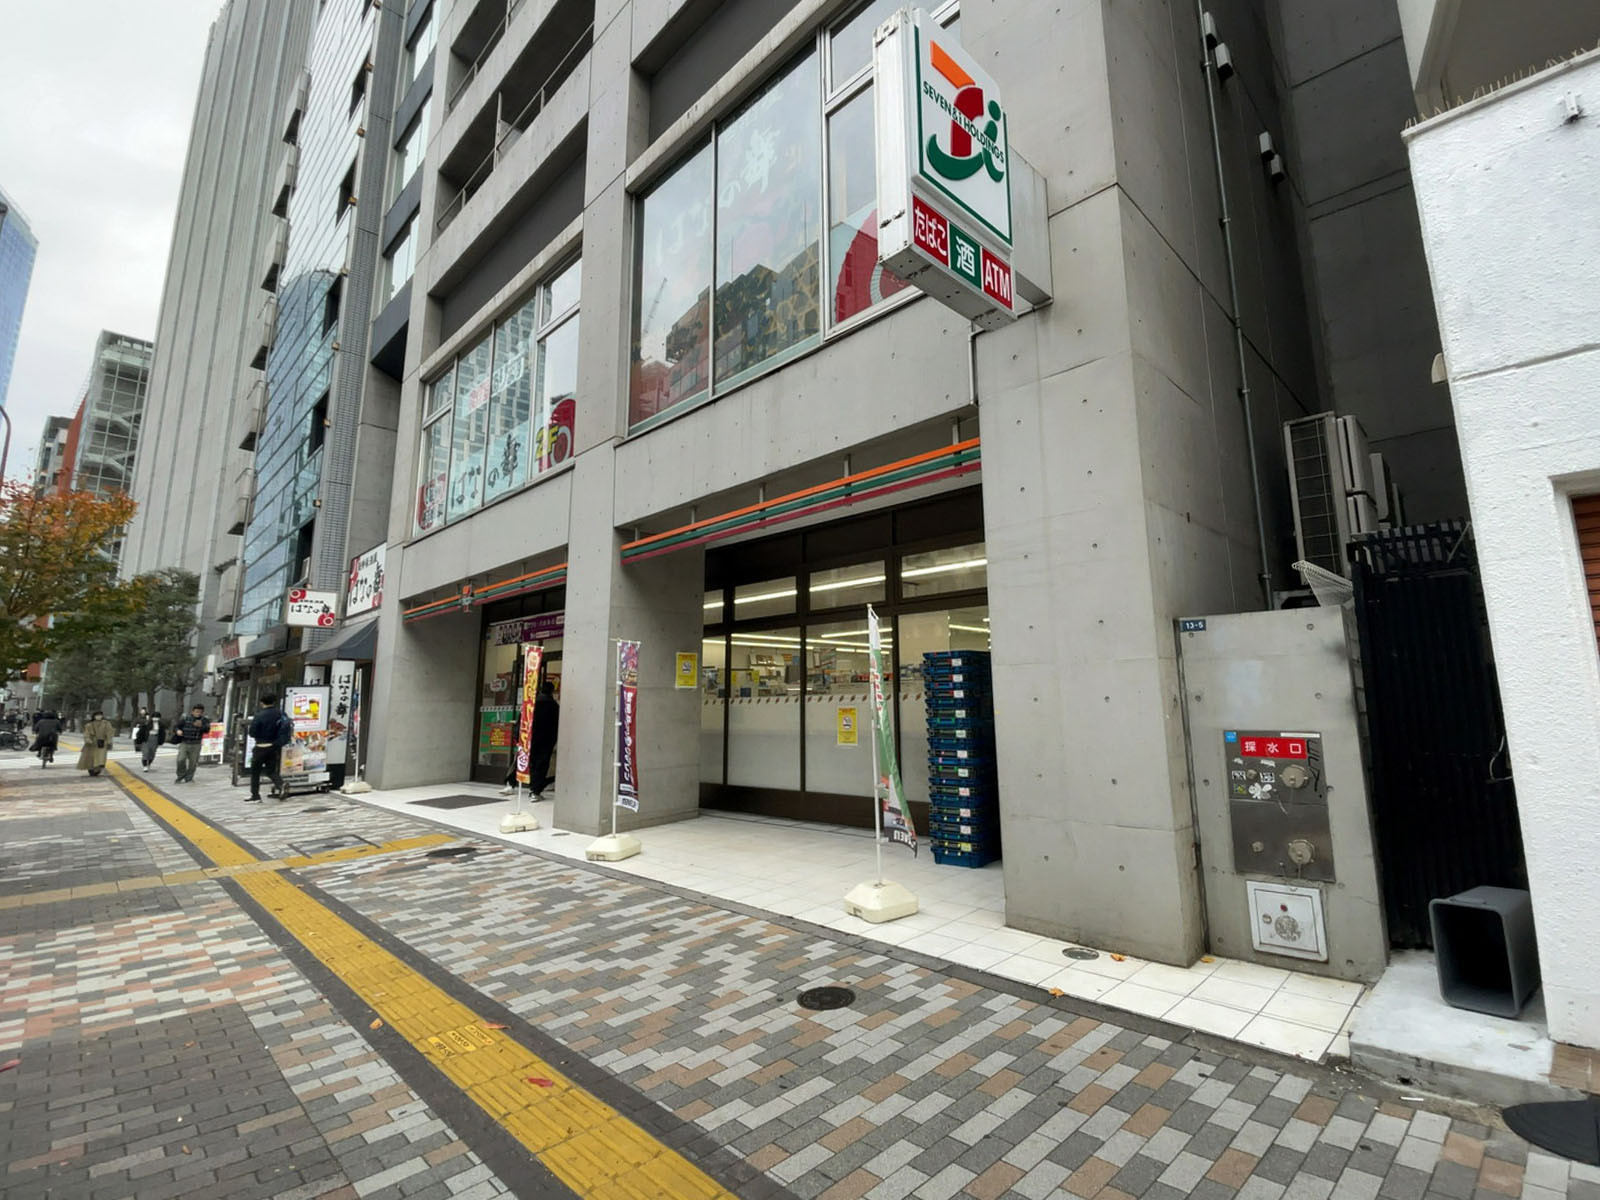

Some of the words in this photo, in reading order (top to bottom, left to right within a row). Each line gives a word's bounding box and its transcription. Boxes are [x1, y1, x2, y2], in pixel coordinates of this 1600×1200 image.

[923, 80, 952, 116] SEVEN
[963, 117, 1005, 164] HOLDINGS
[914, 206, 947, 257] たばこ
[955, 235, 975, 277] 酒
[984, 259, 1011, 302] ATM
[535, 425, 559, 461] 2F
[1185, 620, 1204, 630] 13-5
[1244, 740, 1302, 755] 採水口
